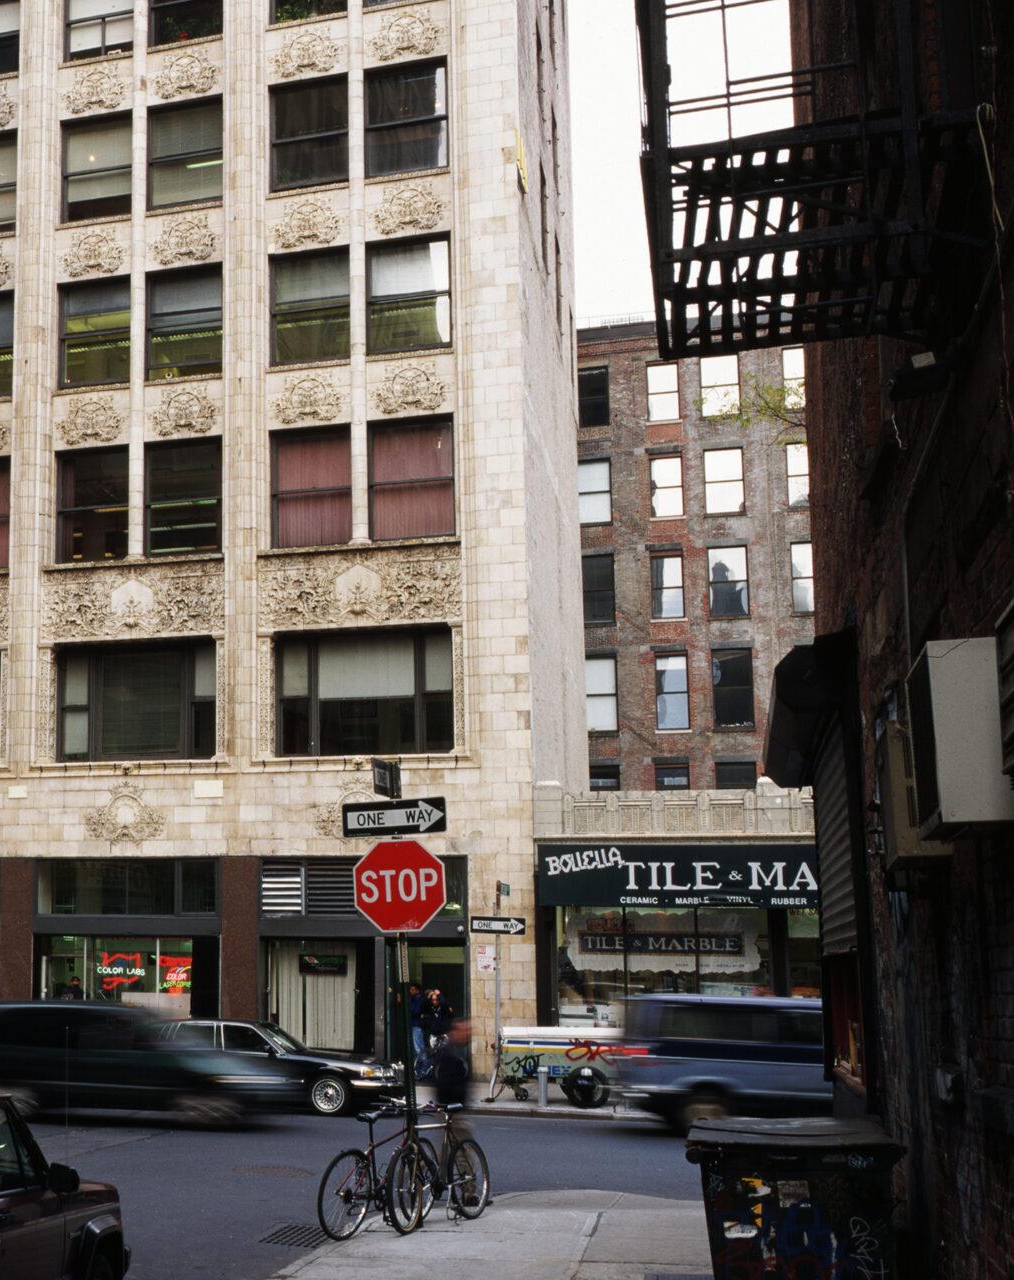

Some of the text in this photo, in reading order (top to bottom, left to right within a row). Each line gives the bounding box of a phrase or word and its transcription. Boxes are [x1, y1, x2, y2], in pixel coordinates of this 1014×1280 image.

[357, 809, 435, 827] ONE WAY
[619, 862, 818, 891] TILE & MA
[361, 868, 438, 903] STOP
[620, 895, 807, 905] CERAMIC MARBLE VINYL RUBBER
[477, 921, 519, 931] ONE WAY
[584, 936, 624, 950] TILE
[648, 937, 739, 951] MARBLE
[97, 966, 146, 977] COLOR LABS
[166, 973, 188, 981] COLOR
